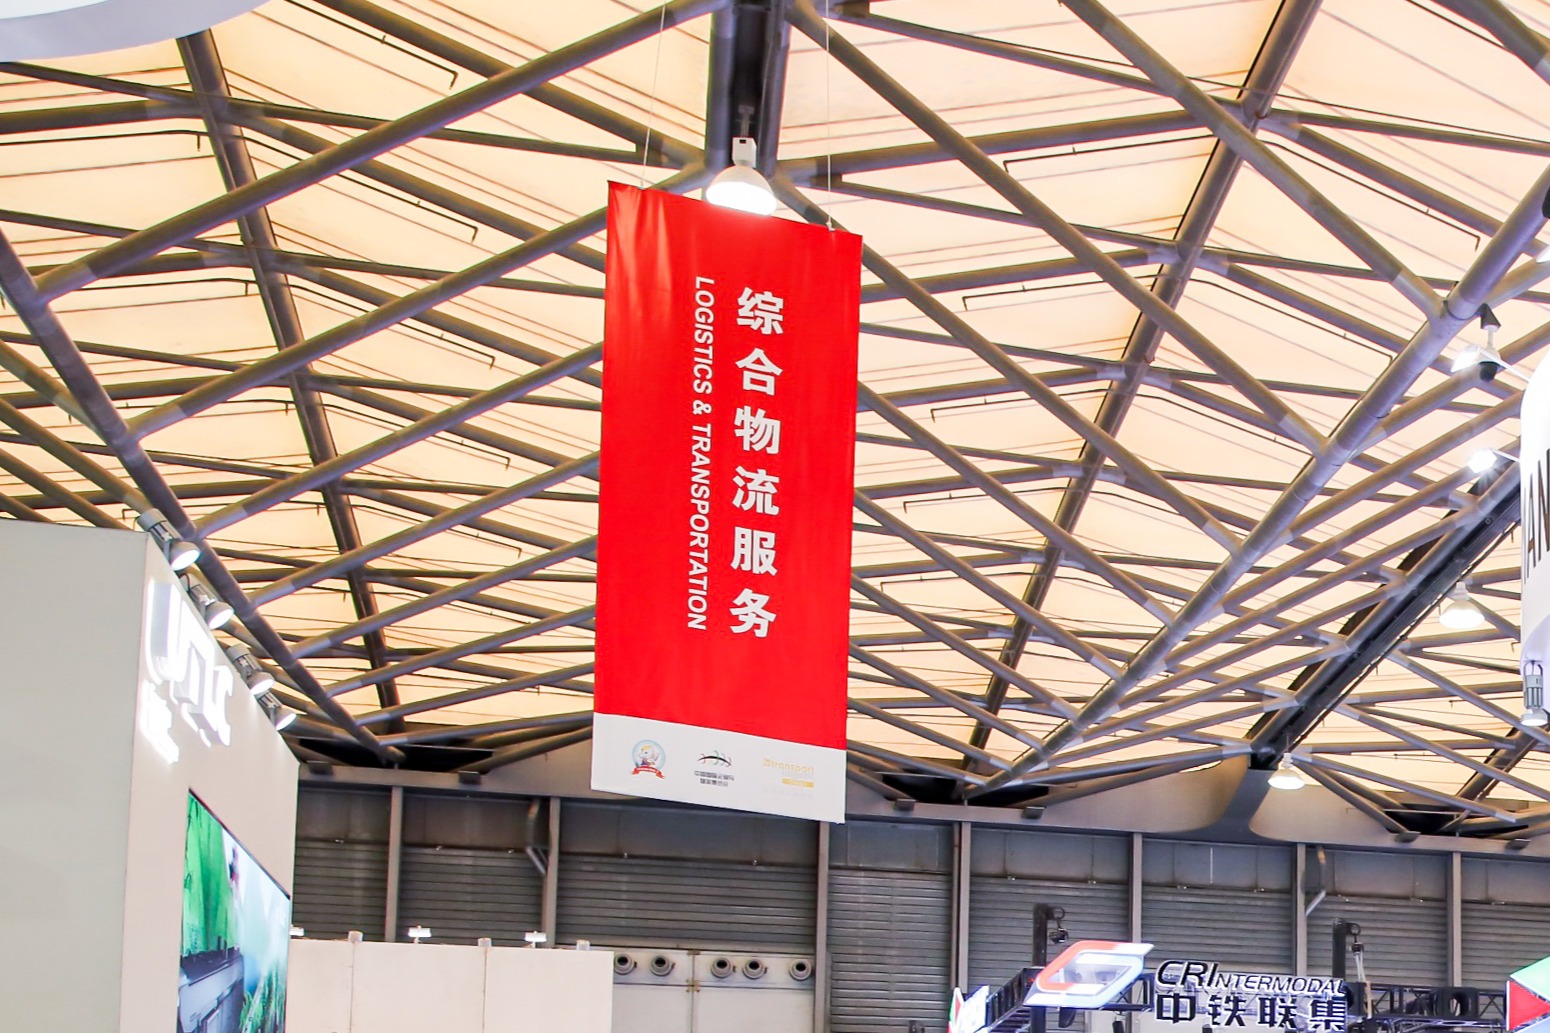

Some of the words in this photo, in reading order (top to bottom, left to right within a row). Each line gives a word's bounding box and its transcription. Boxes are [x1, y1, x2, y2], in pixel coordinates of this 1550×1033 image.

[693, 276, 715, 394] LOGISTICS
[692, 399, 713, 417] &
[729, 287, 784, 640] 综合物流服务
[687, 422, 713, 632] TRANSPORTATION
[1155, 992, 1348, 1032] 中铁联集
